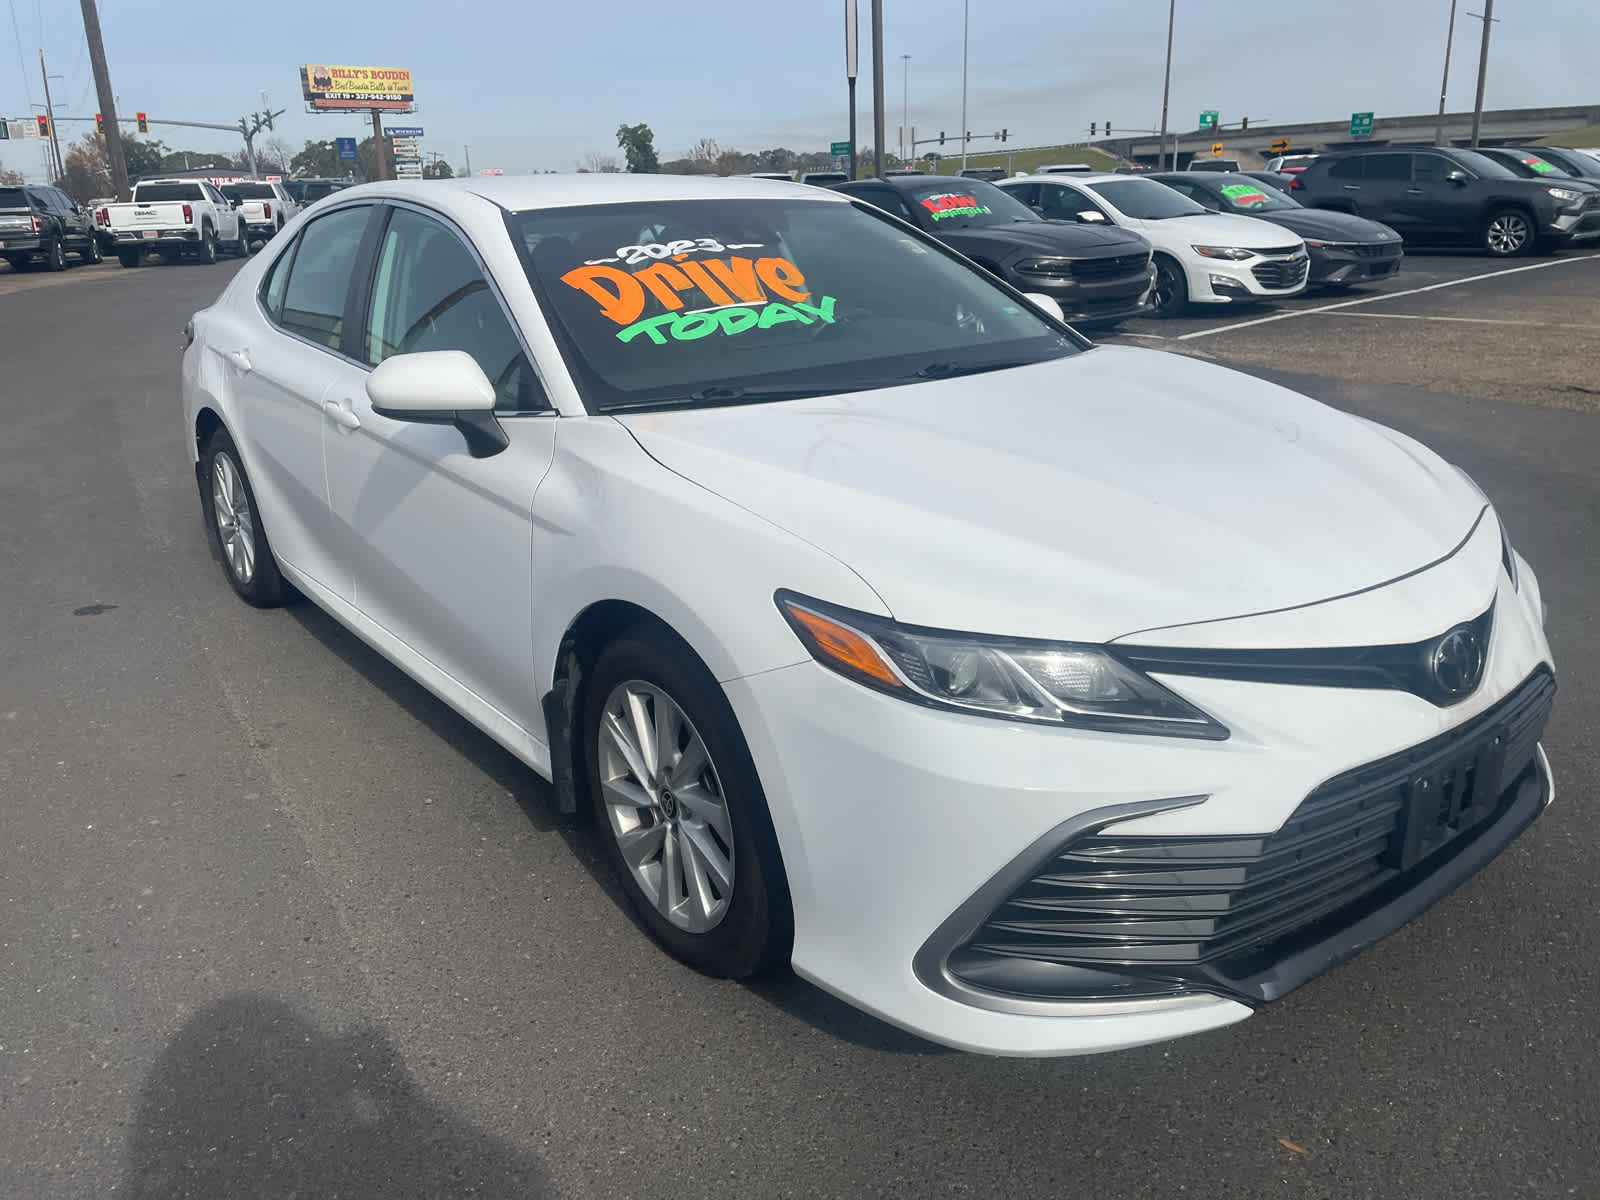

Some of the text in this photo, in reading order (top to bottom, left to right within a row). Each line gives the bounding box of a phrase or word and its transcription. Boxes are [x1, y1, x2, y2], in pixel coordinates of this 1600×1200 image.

[331, 69, 410, 80] BILLY'S BOUDIN
[920, 195, 978, 214] LOW
[616, 238, 726, 264] 2023
[560, 254, 812, 325] Drive
[616, 295, 837, 344] TODAY
